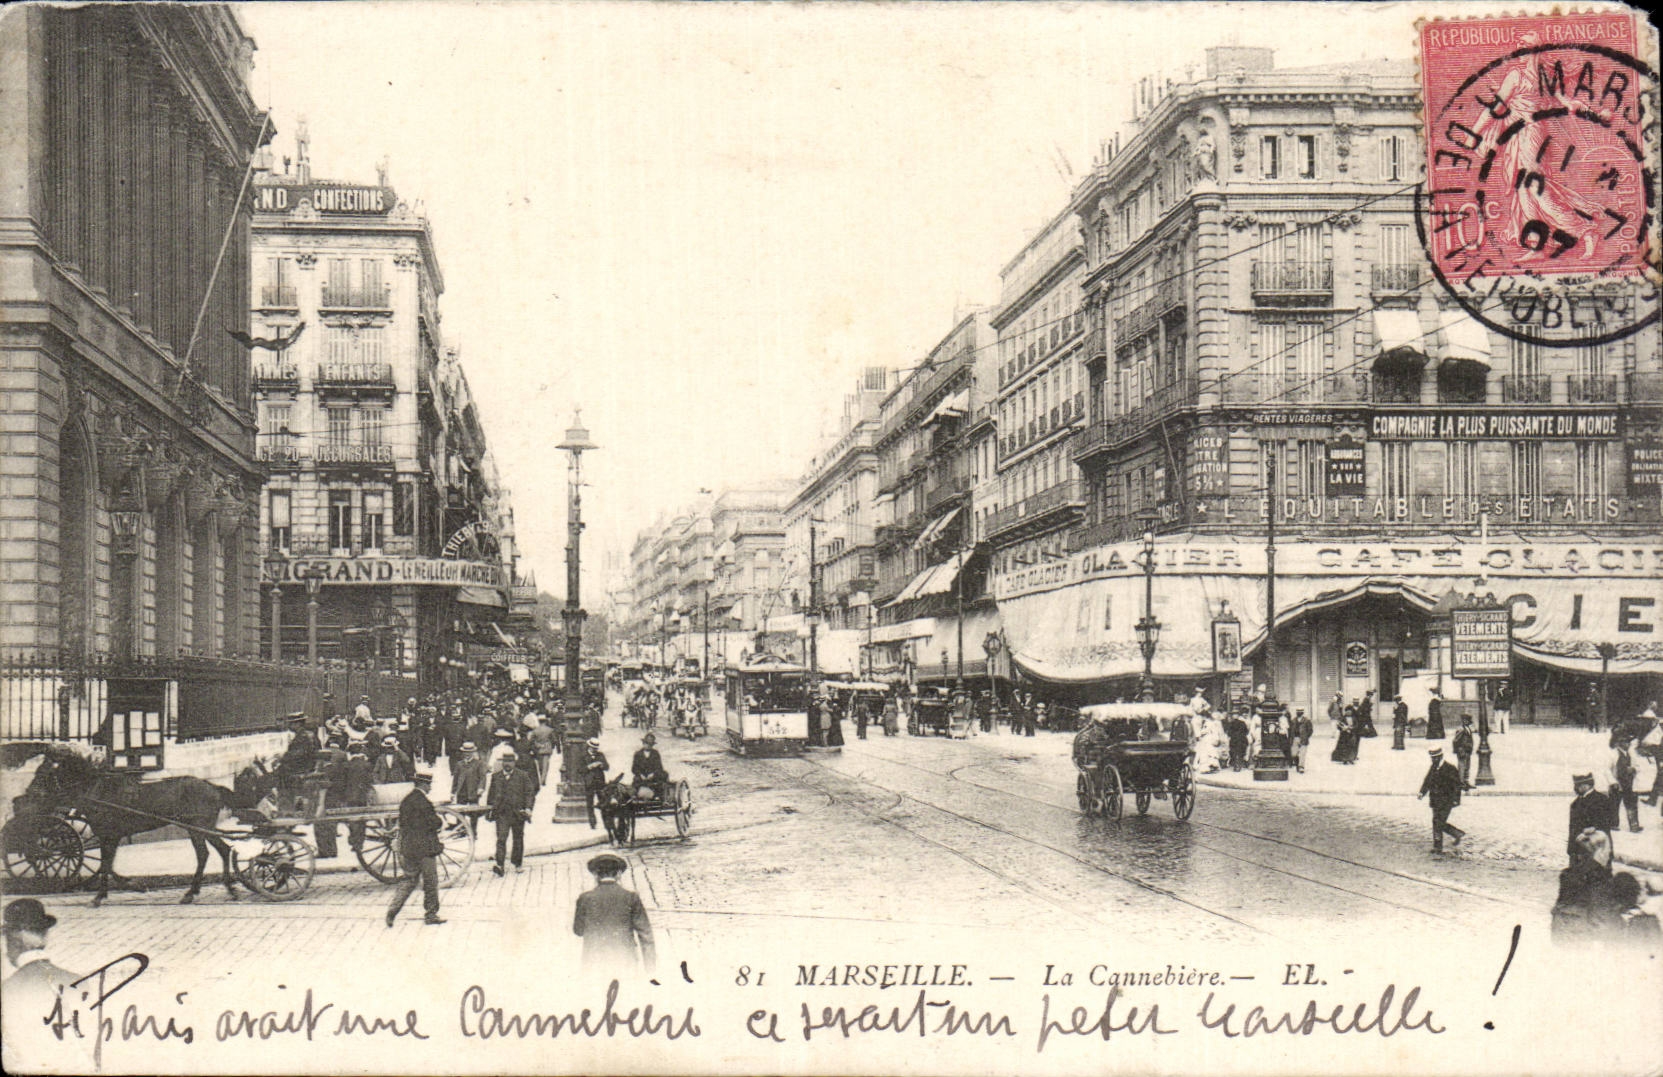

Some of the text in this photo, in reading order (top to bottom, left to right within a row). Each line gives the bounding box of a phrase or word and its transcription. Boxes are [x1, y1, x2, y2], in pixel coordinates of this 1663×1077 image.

[1545, 21, 1628, 40] FRANÇAISE
[313, 189, 384, 212] CONFECTIONS
[326, 364, 382, 381] ENFANTS
[1253, 413, 1333, 424] RENTES VIAGERES
[1372, 415, 1618, 434] COMPAGNIE LA PLUS PUISSANTE DU MONDE
[1330, 473, 1364, 484] LA VIE
[1454, 622, 1509, 635] VETEMENTS
[70, 952, 194, 1073] Paris
[333, 1008, 430, 1041] une
